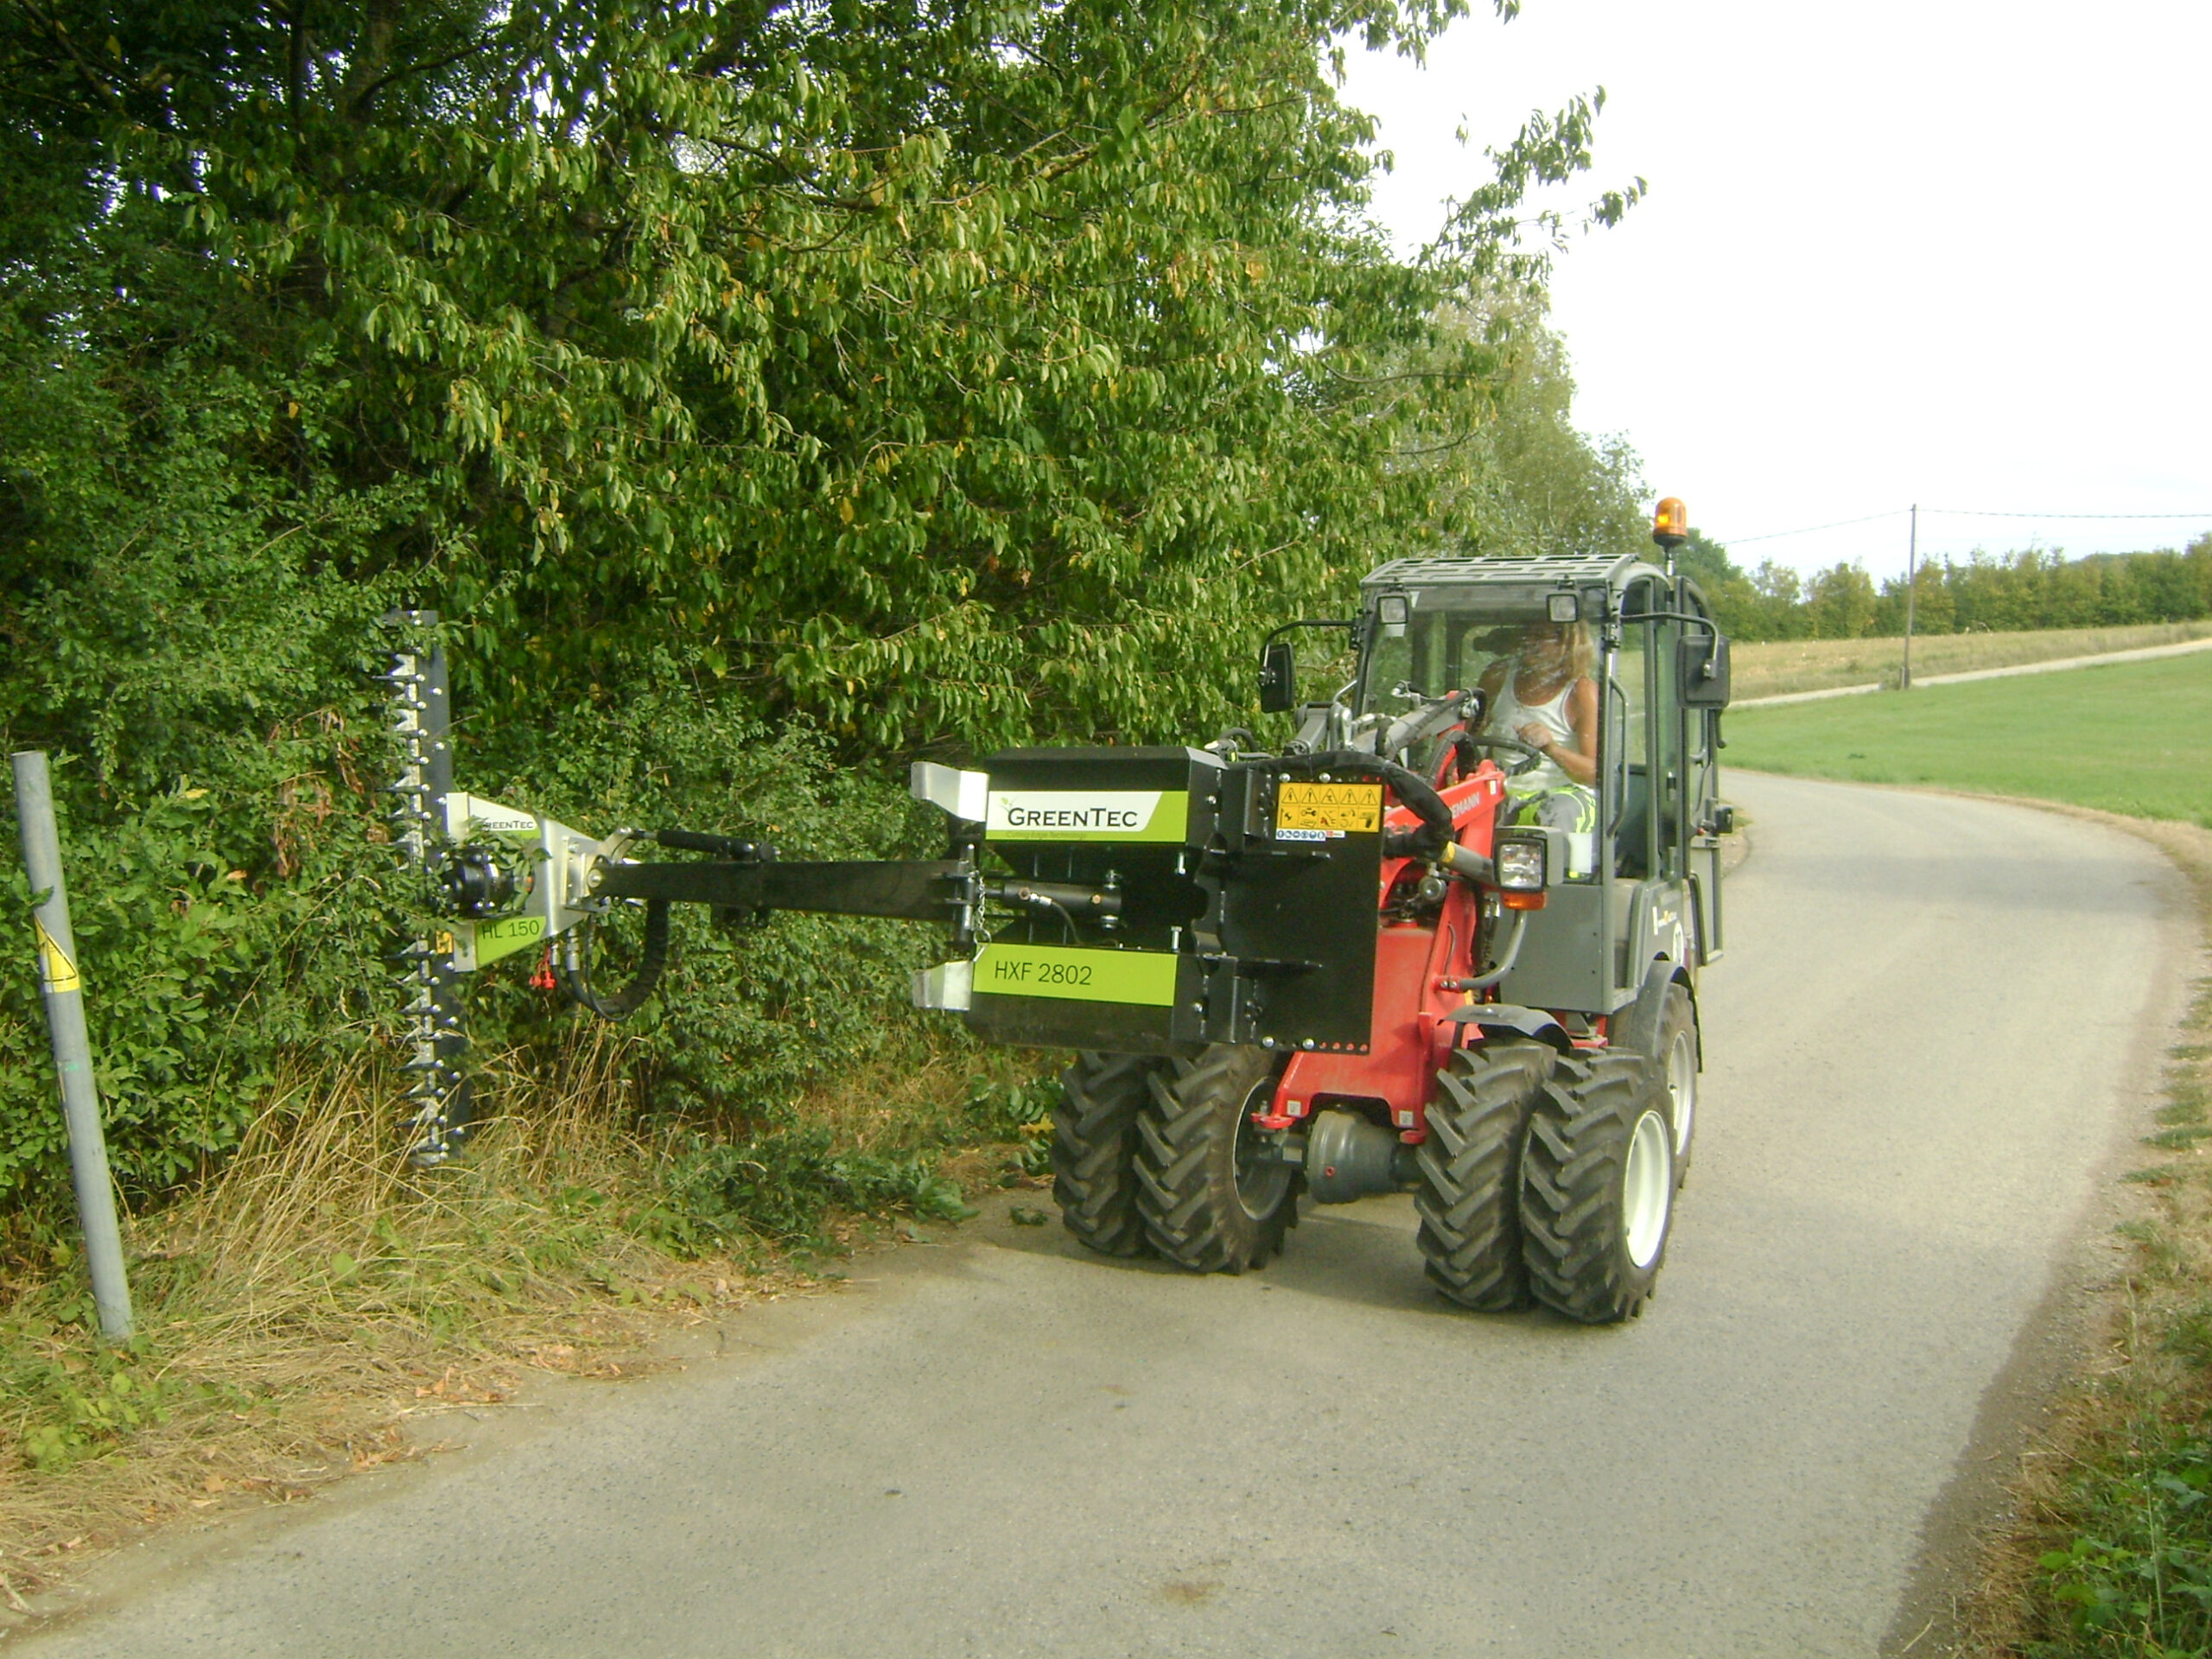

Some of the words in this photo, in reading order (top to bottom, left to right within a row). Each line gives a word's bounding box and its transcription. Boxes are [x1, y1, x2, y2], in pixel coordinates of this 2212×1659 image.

[1449, 791, 1480, 819] EMANN
[482, 820, 534, 830] REENTEC
[482, 923, 503, 939] HL
[508, 919, 540, 938] 150
[995, 960, 1033, 981] HXF
[1038, 963, 1092, 986] 2802
